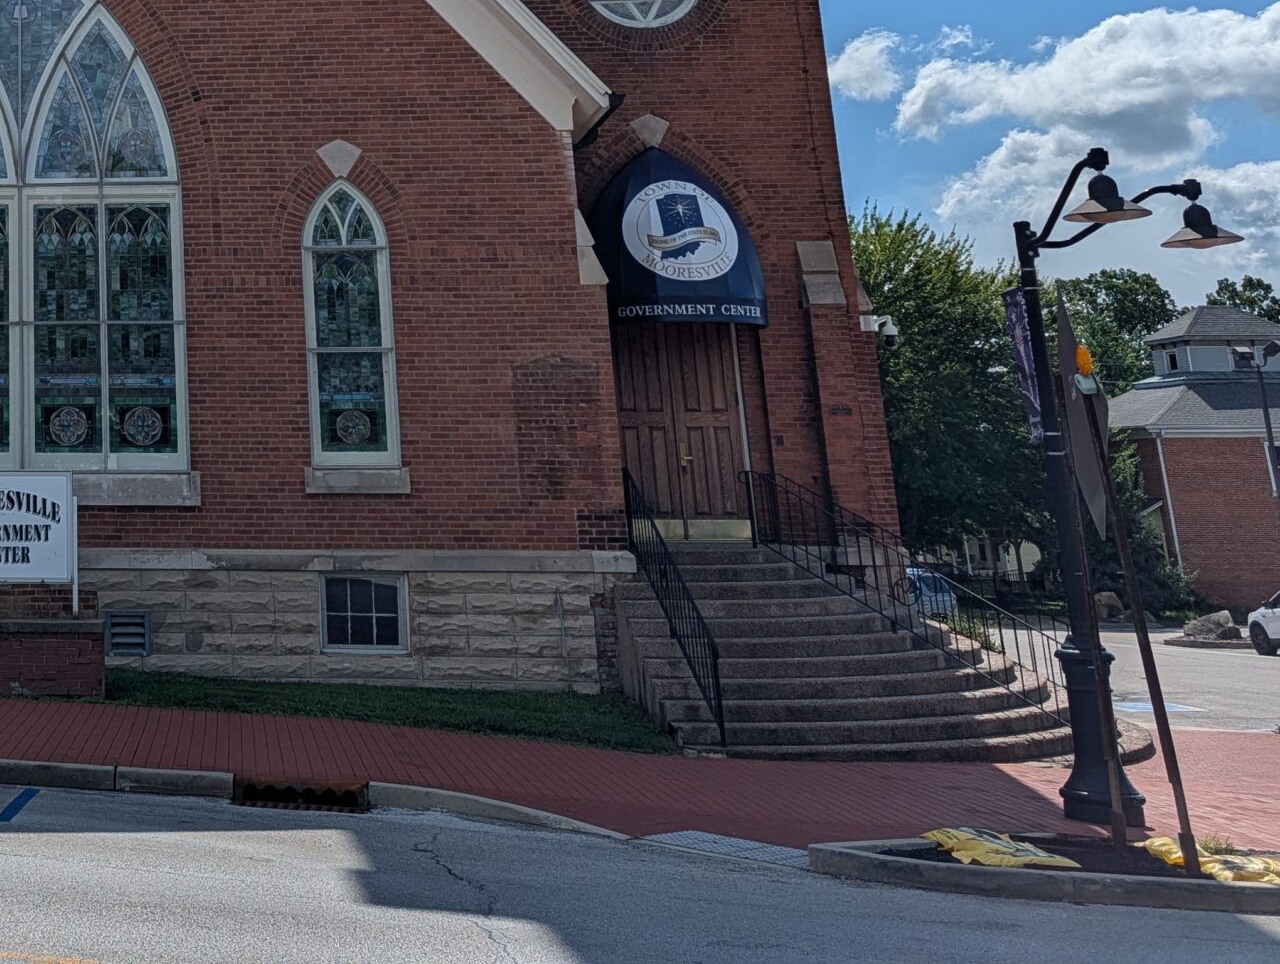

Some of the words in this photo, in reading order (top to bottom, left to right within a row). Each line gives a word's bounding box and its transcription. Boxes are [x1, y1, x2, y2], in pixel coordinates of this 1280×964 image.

[634, 181, 687, 204] TOWN
[693, 187, 713, 203] OF
[641, 251, 733, 279] MOORESVILLE
[618, 304, 716, 317] GOVERNMENT
[721, 304, 761, 317] CENTER
